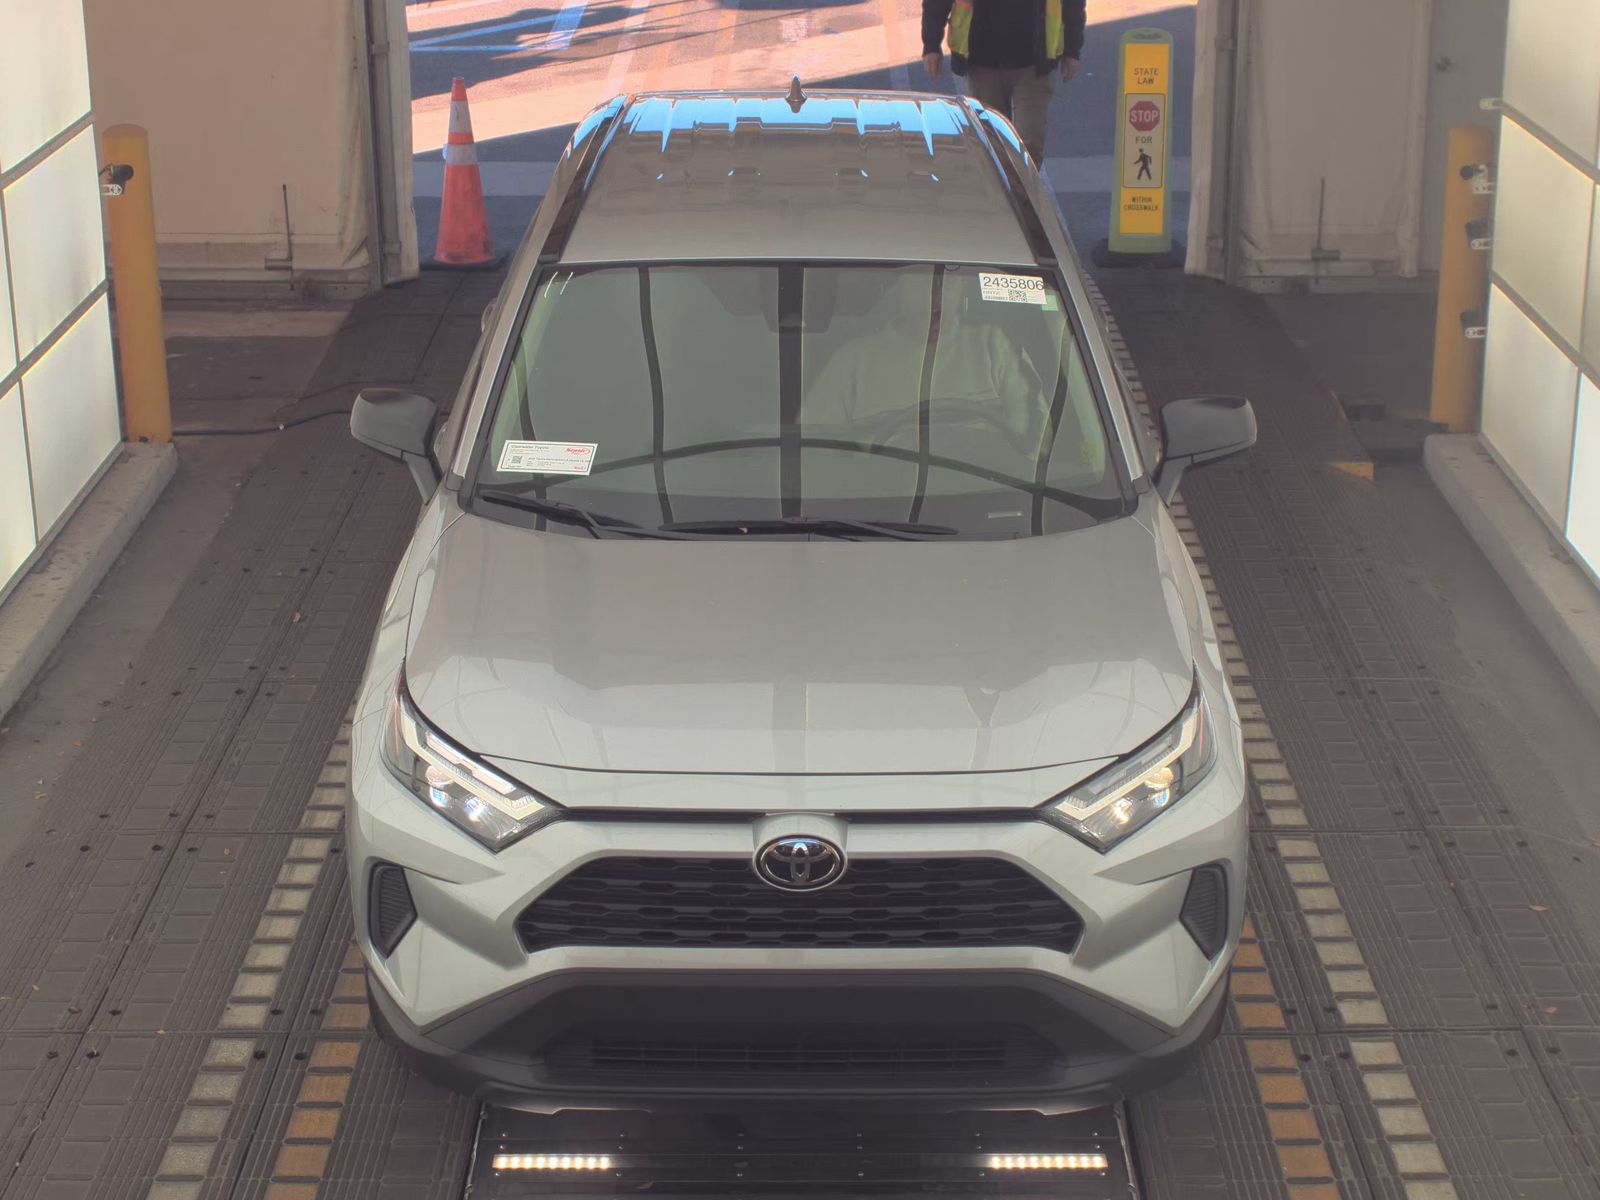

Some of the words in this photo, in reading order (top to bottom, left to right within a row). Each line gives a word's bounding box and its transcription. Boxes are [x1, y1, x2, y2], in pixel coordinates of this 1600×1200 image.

[1134, 68, 1159, 77] STATE
[1137, 77, 1155, 86] LAW
[1130, 110, 1159, 123] STOP
[1135, 136, 1153, 144] FOR
[1123, 203, 1158, 212] CROSSWALK
[983, 276, 1045, 291] 2435806
